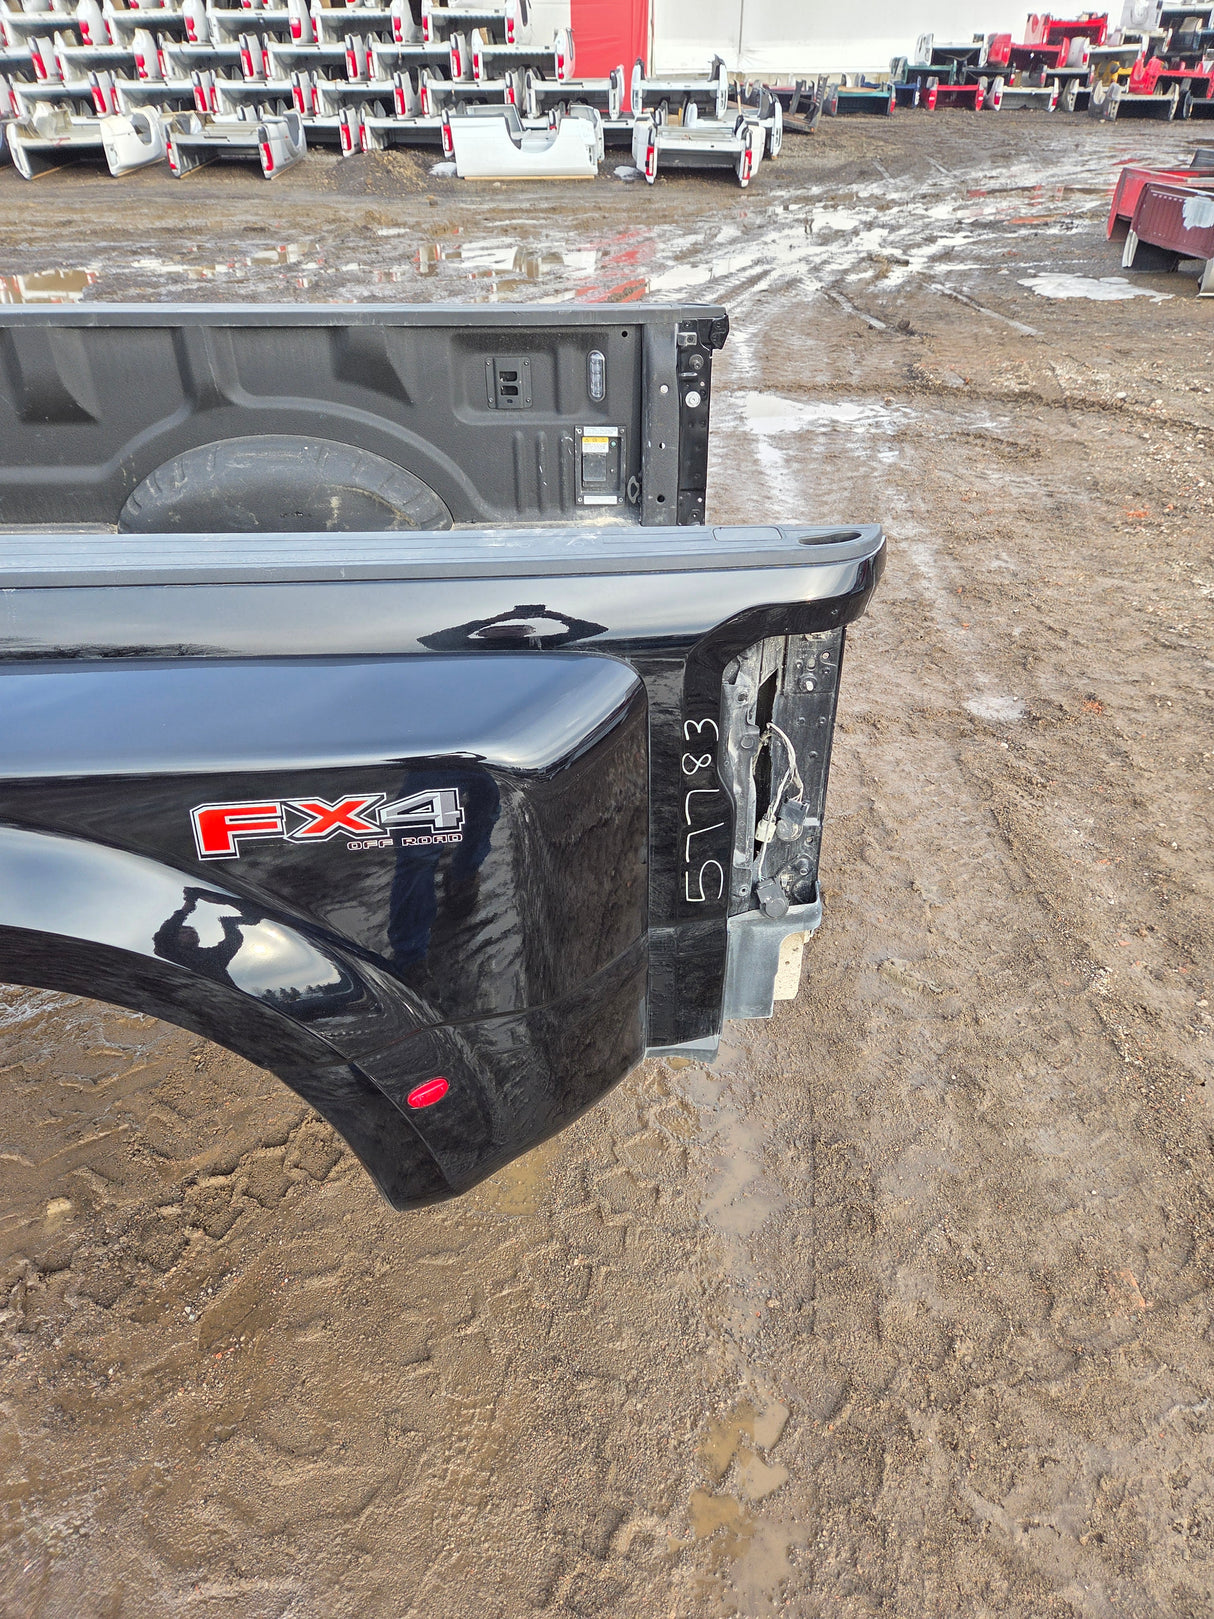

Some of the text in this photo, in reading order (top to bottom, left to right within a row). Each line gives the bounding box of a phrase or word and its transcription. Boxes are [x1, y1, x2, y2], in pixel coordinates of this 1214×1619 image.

[190, 788, 465, 860] FX4
[346, 833, 463, 851] OFF ROAD
[682, 718, 724, 902] 57783
